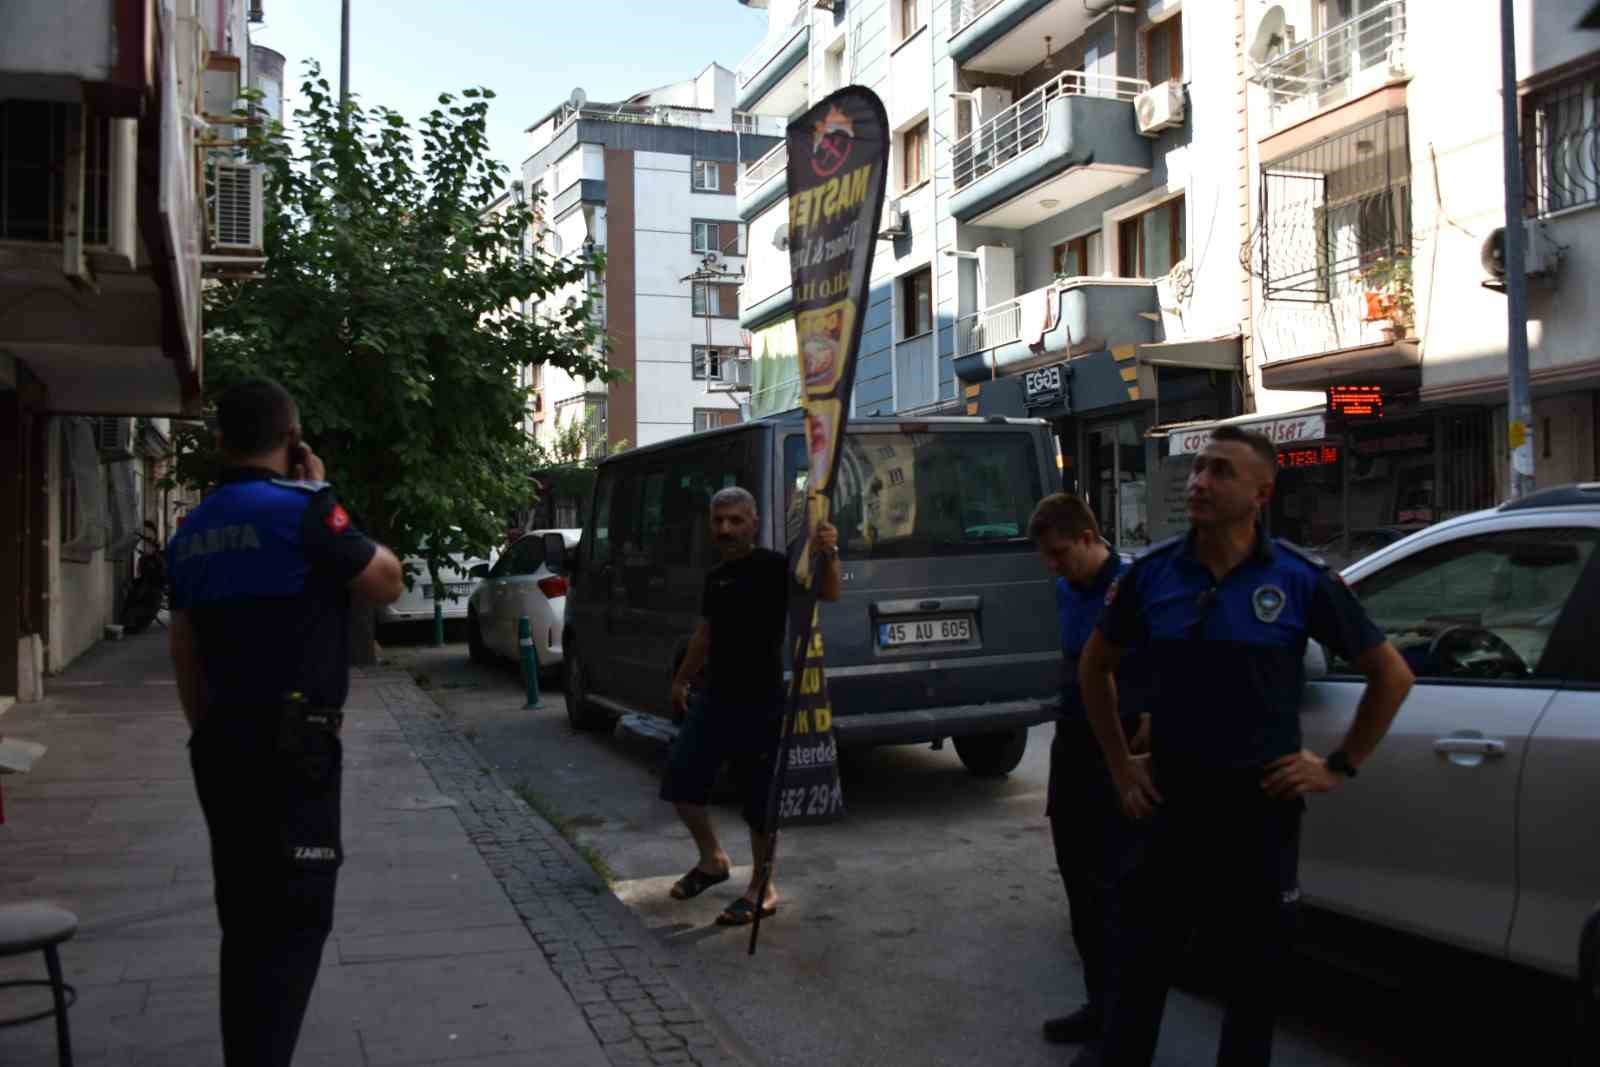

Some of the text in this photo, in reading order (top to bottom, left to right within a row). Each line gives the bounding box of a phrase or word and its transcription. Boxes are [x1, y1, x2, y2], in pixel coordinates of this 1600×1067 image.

[887, 620, 969, 642] 45 AU 605
